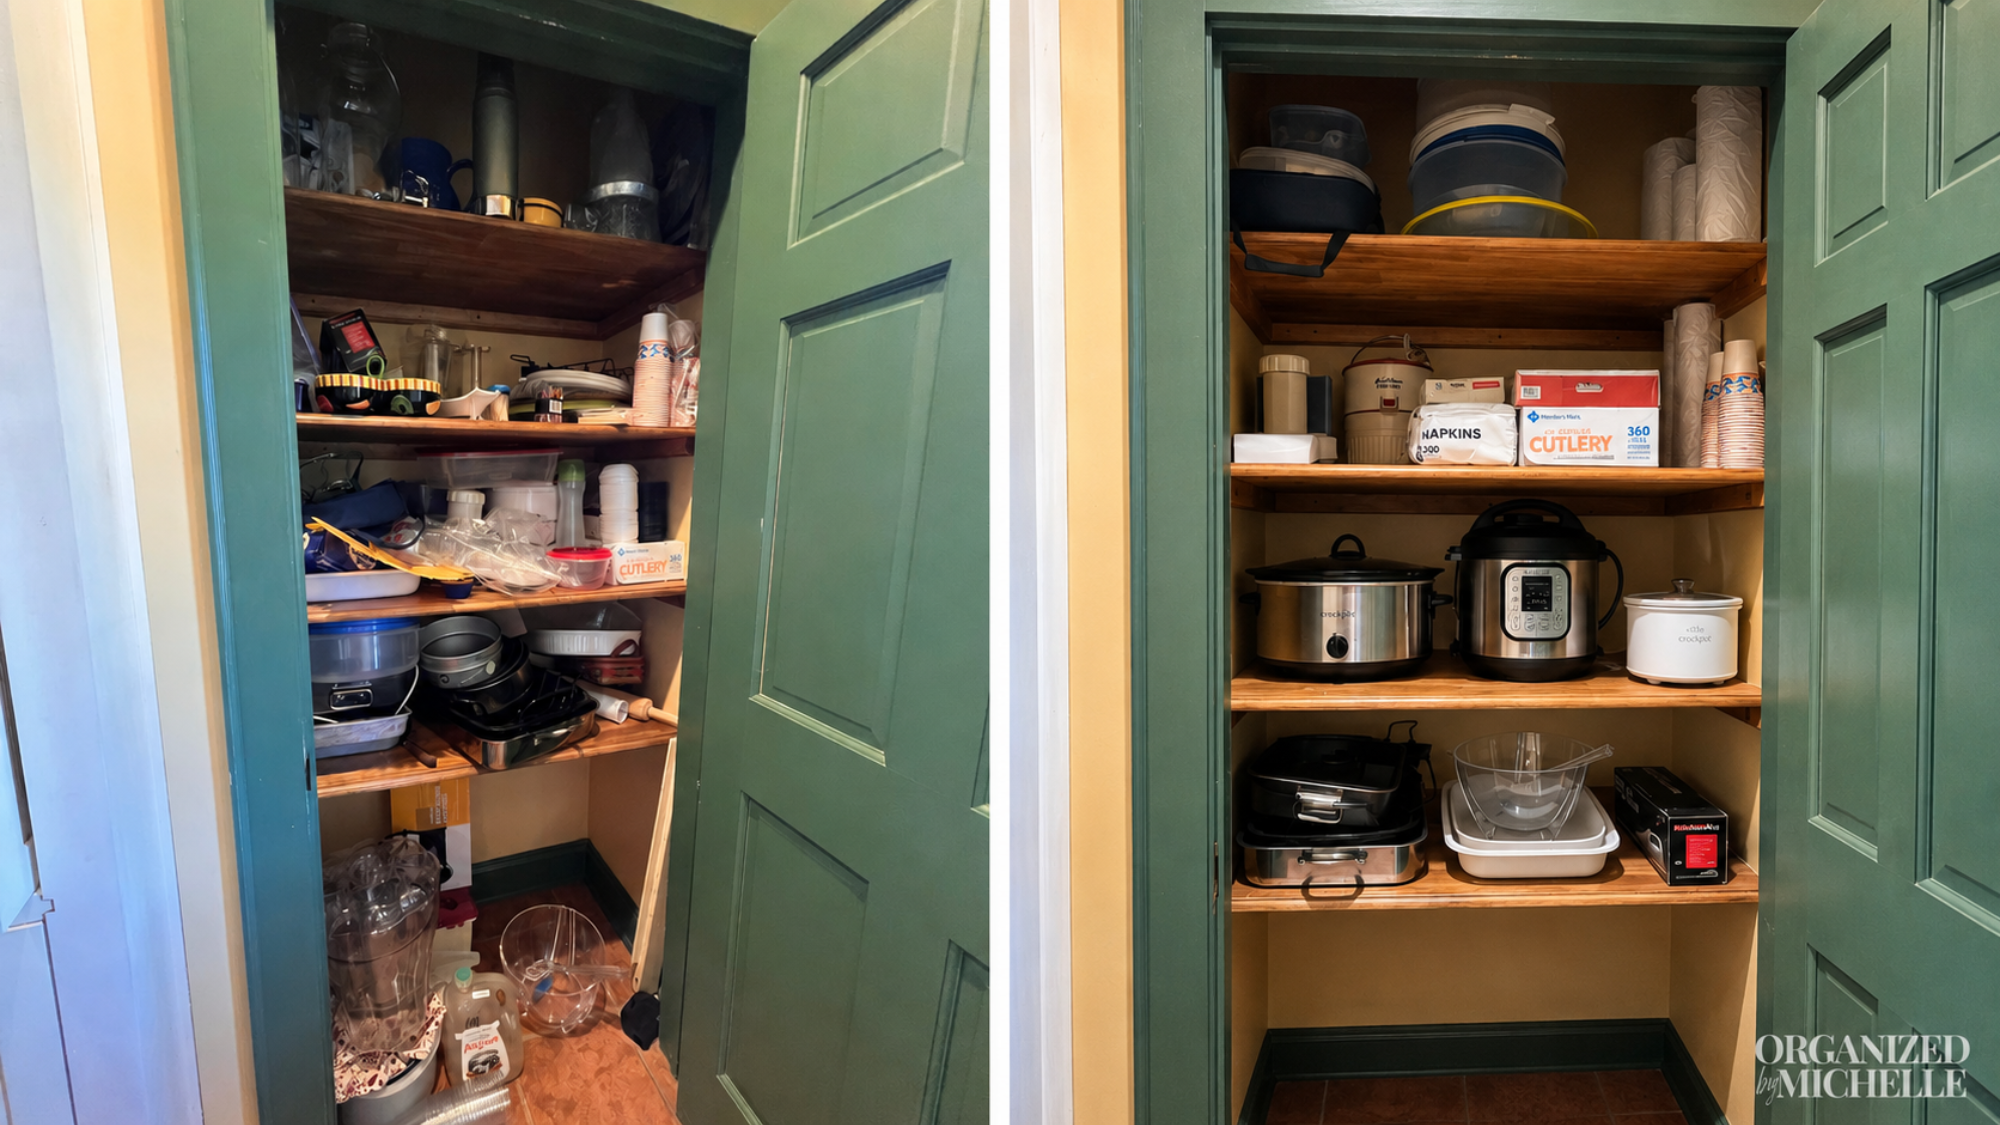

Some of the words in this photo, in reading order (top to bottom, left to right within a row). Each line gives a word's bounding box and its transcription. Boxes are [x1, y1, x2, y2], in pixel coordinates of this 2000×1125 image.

[1422, 428, 1481, 440] NAPKINS
[1627, 426, 1650, 436] 360
[1529, 435, 1613, 453] CUTLERY
[619, 560, 667, 578] CUTLERY
